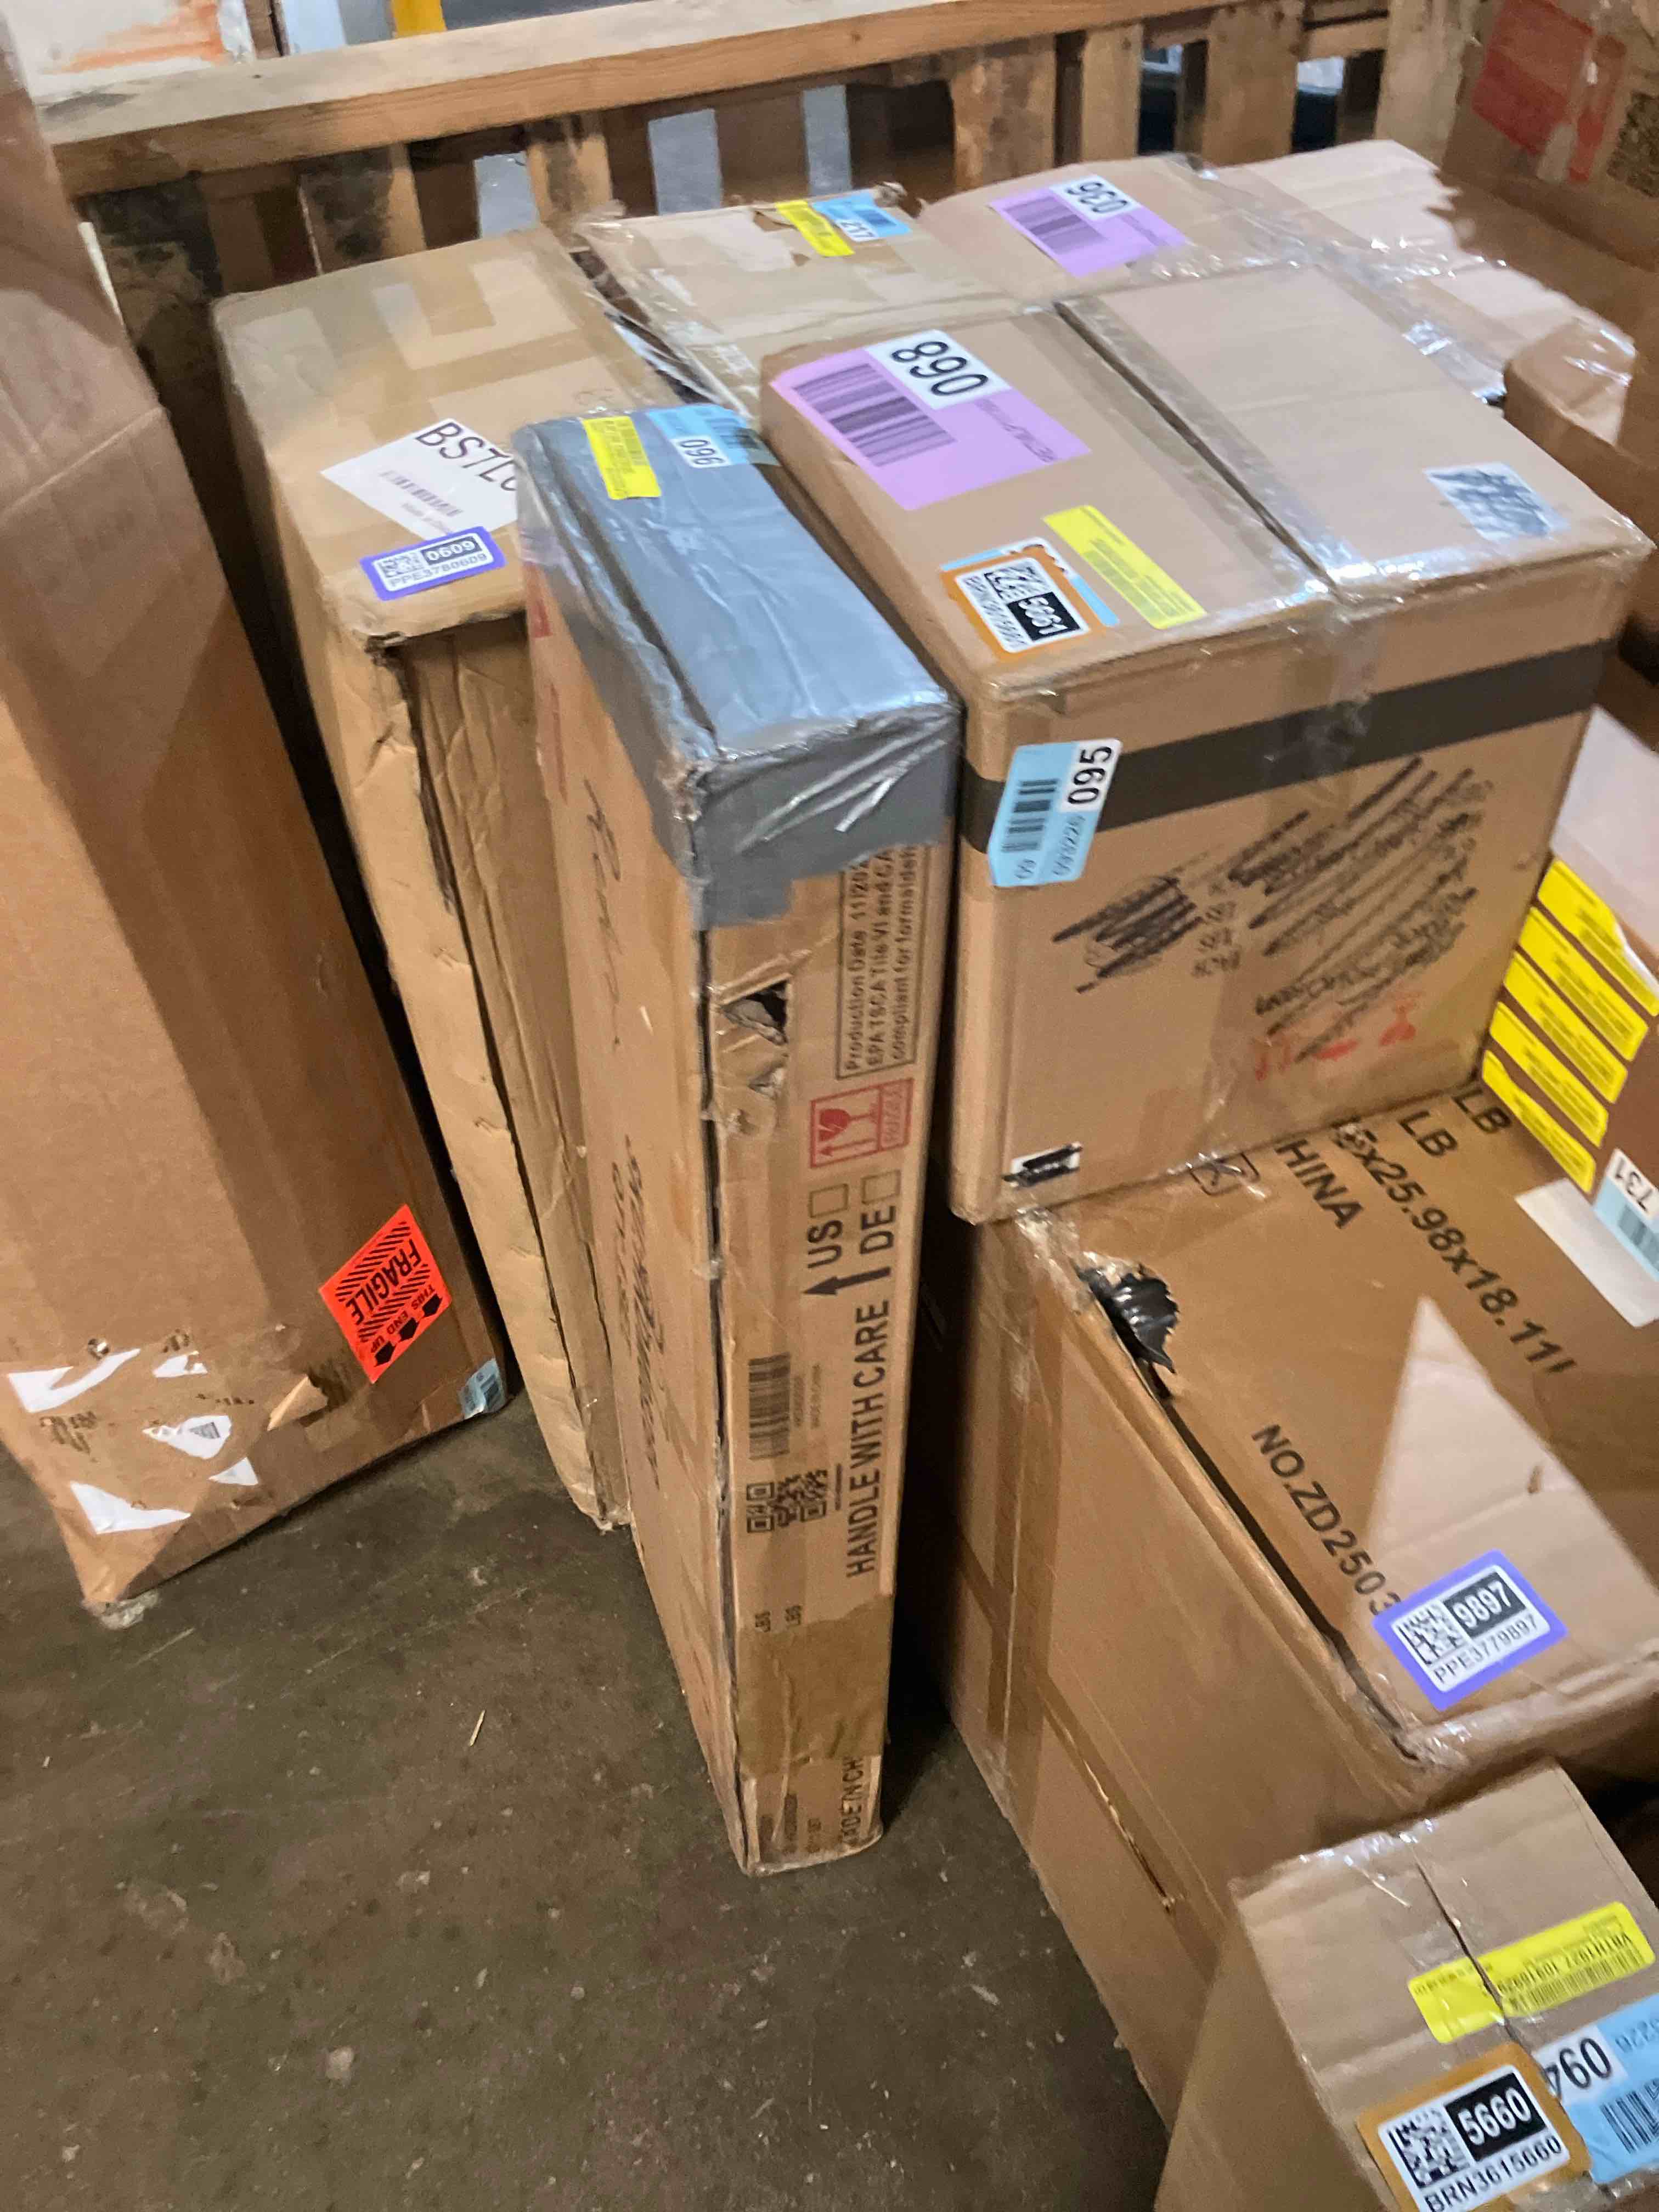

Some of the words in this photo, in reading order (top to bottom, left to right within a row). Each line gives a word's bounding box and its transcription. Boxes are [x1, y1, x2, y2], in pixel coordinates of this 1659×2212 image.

[1067, 746, 1112, 805] 095
[1397, 1111, 1458, 1156] LB
[1274, 1138, 1364, 1230] HINA
[808, 1219, 844, 1269] US
[860, 1205, 896, 1256] DE
[345, 1239, 422, 1326] FRAGILE
[411, 1284, 436, 1311] THIS
[370, 1335, 385, 1353] UP
[386, 1310, 409, 1335] END
[854, 1299, 890, 1389] CARE
[850, 1391, 885, 1469] WITH
[847, 1469, 881, 1578] HANDLE
[1455, 1582, 1514, 1629] 9897
[1457, 2086, 1532, 2146] 5660
